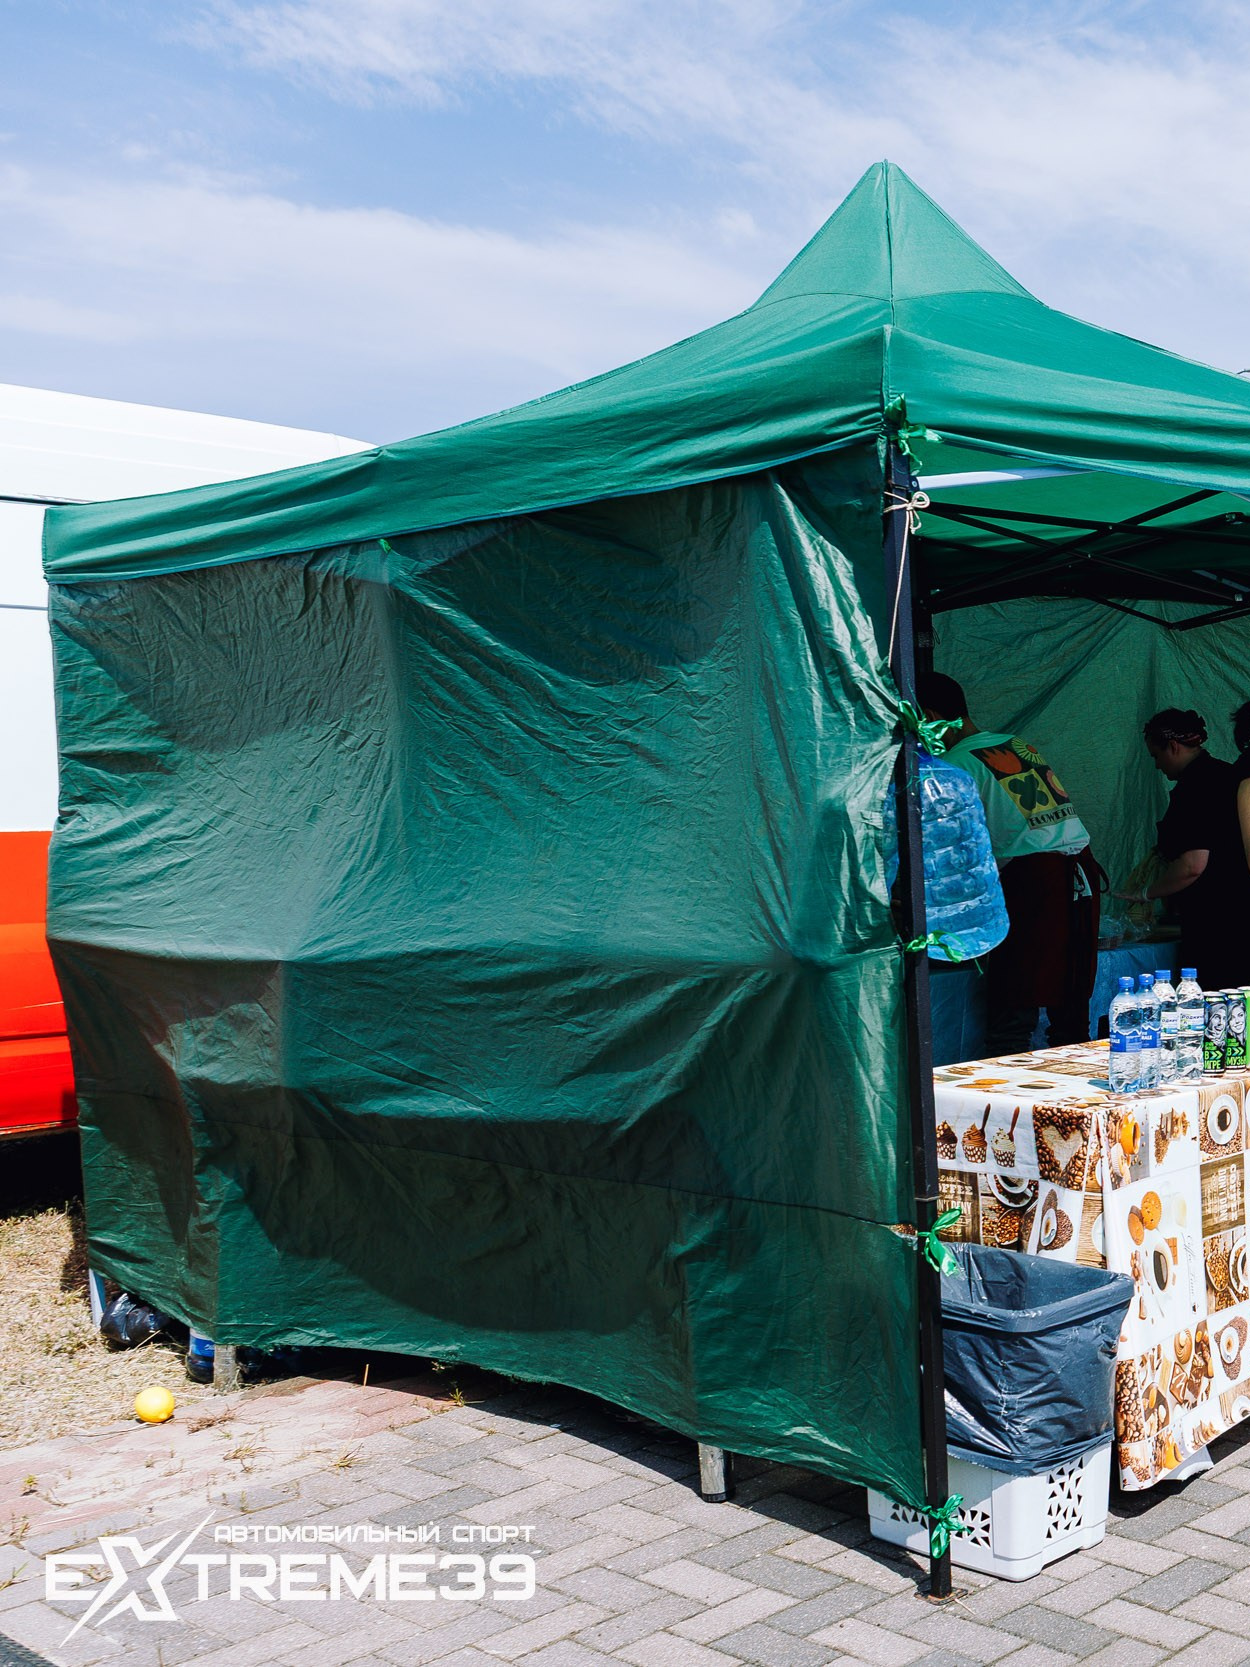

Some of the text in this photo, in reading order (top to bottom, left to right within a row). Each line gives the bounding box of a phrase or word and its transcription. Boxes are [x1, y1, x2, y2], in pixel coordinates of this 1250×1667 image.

[1204, 1060, 1221, 1069] ИГРЕ
[938, 1183, 973, 1196] FFEE
[1217, 1168, 1229, 1222] DON'T DENY
